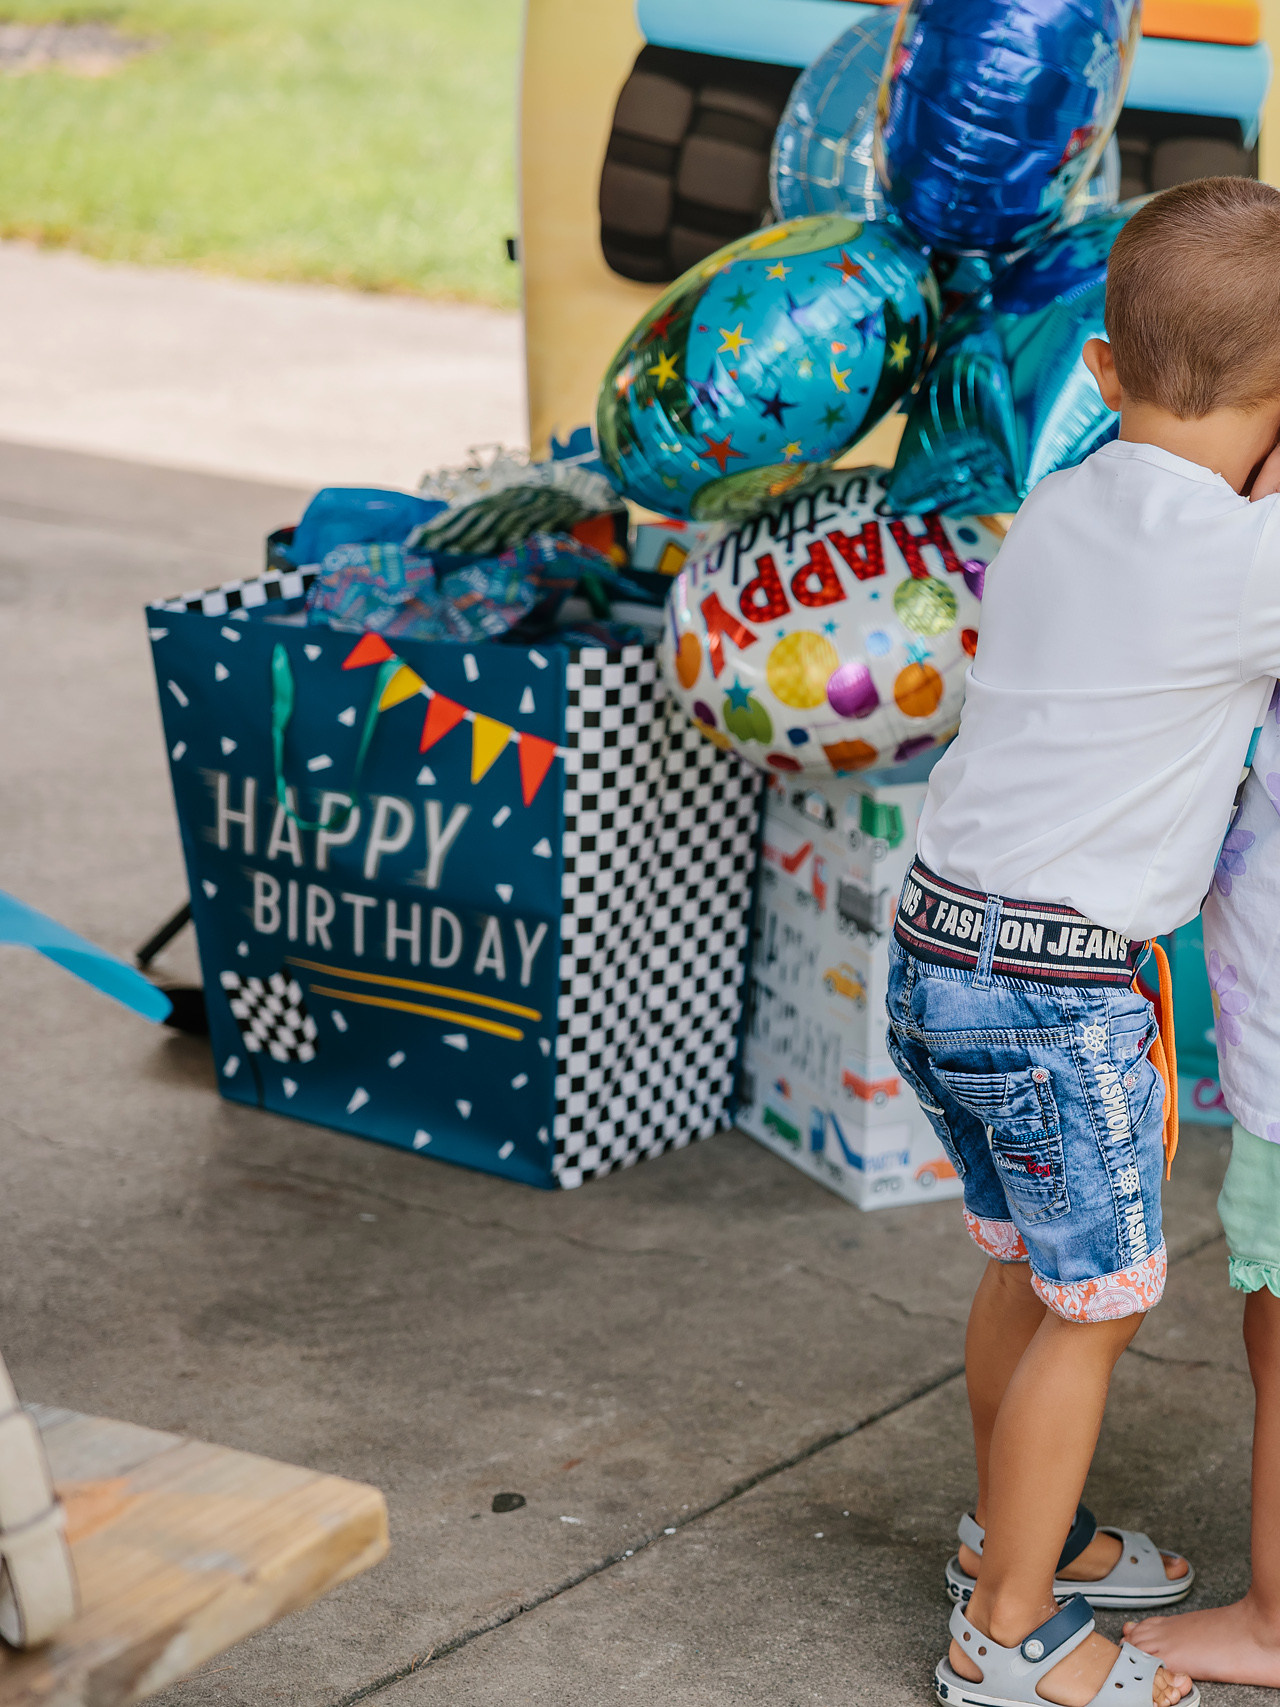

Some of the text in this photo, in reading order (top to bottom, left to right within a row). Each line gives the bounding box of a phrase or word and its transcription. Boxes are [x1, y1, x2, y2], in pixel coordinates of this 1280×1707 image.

[700, 513, 963, 679] HAPPY
[212, 771, 472, 890] HAPPY
[252, 871, 548, 987] BIRTHDAY
[931, 900, 1045, 954] FASHON
[1046, 926, 1131, 962] JEANS
[1093, 1062, 1130, 1144] FASHION
[1026, 1161, 1051, 1178] Boy
